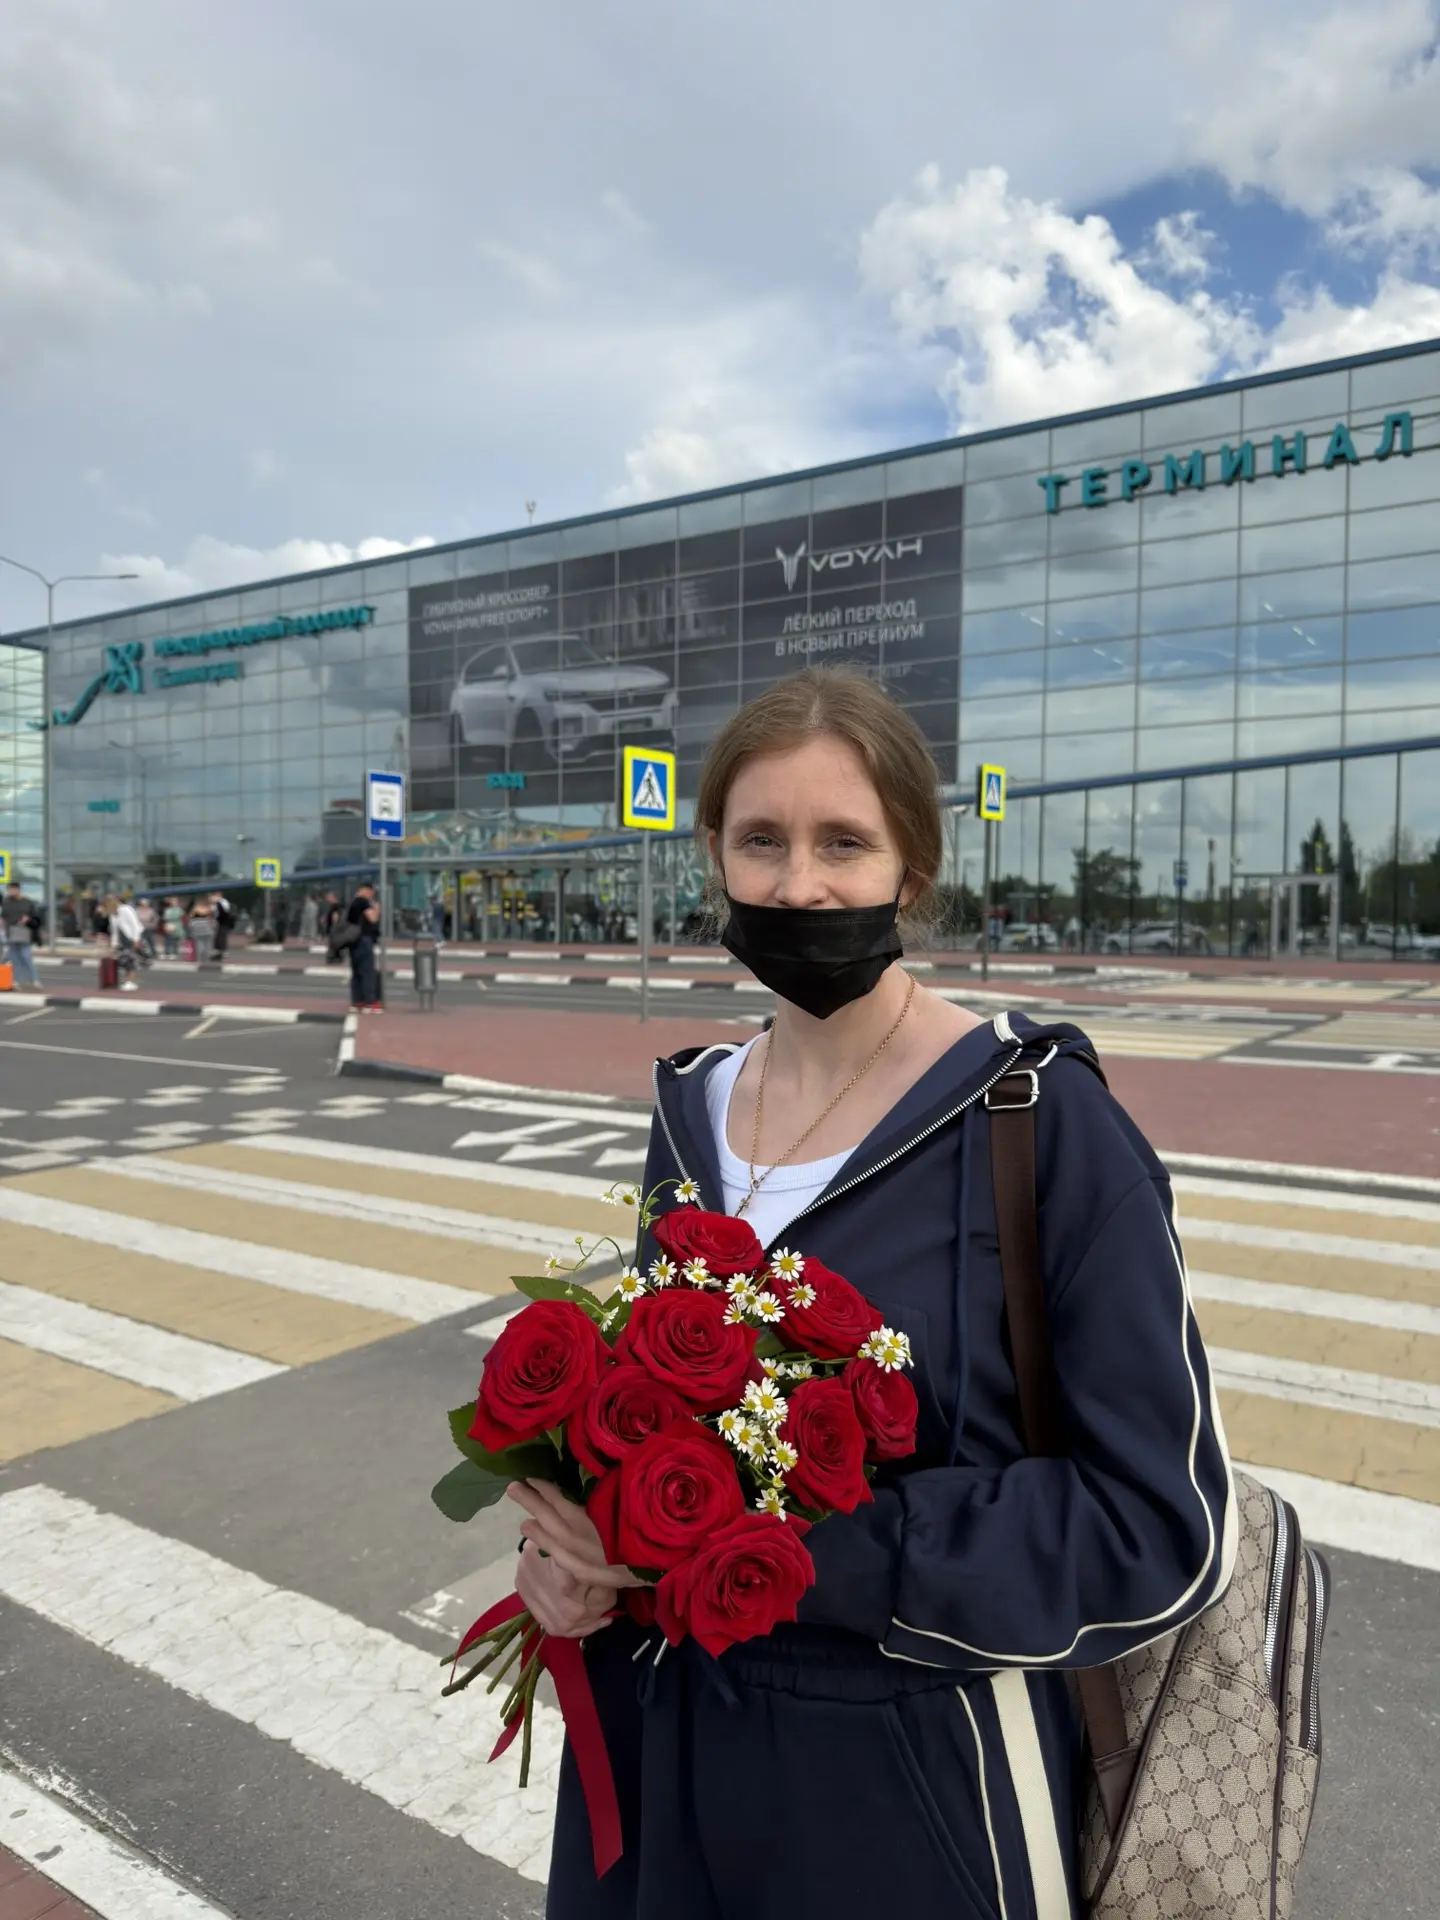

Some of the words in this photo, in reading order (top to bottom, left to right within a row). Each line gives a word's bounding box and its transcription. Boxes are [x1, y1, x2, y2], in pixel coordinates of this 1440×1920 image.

[1037, 411, 1414, 514] ТЕРМИНАЛ
[808, 537, 923, 573] VOYAH
[782, 606, 843, 634] ЛЁГКИЙ
[845, 598, 918, 625] ПЕРЕХОД
[775, 641, 785, 657] В
